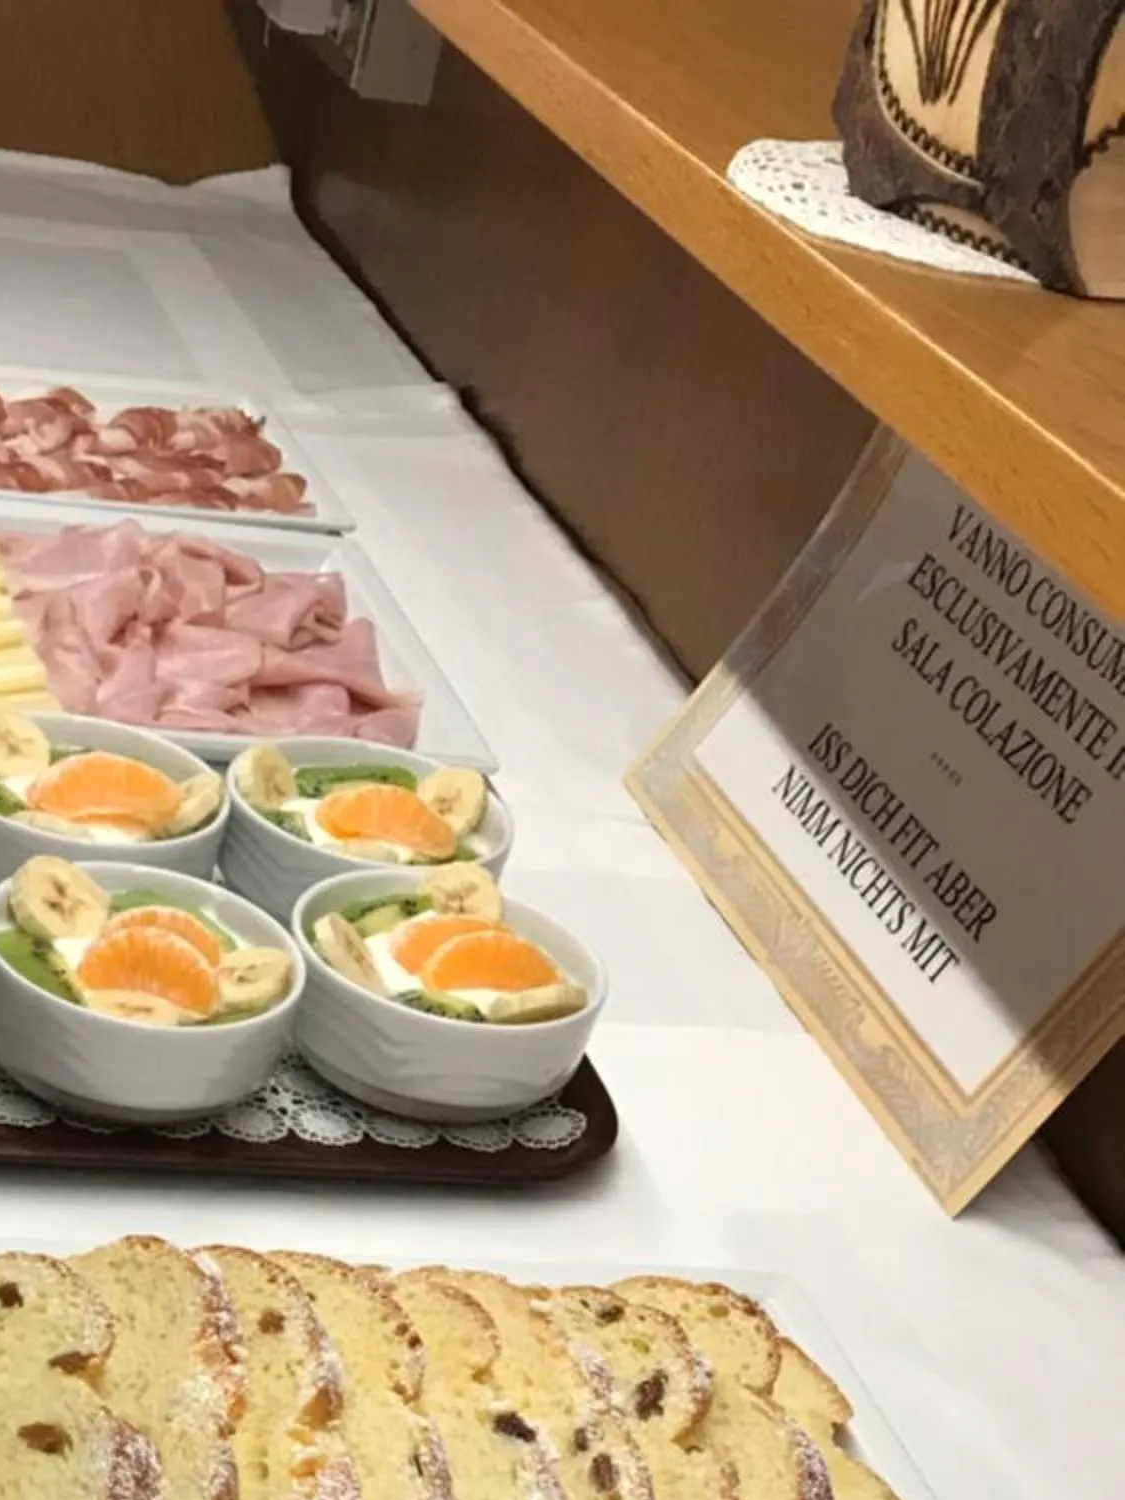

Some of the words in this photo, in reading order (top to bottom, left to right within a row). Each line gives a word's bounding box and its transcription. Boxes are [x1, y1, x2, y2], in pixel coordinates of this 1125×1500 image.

[946, 503, 1032, 597] VANNO
[890, 617, 955, 695] SALA
[949, 675, 1092, 824] COLAZIONE
[907, 553, 1118, 760] ESCLUSIVAMENTE
[772, 765, 842, 848] NIMM
[827, 830, 916, 935] NICHTS
[900, 918, 961, 984] MIT
[807, 722, 852, 774] ISS
[839, 757, 905, 833] DICH
[890, 813, 940, 869] FIT
[923, 860, 997, 942] ABER
